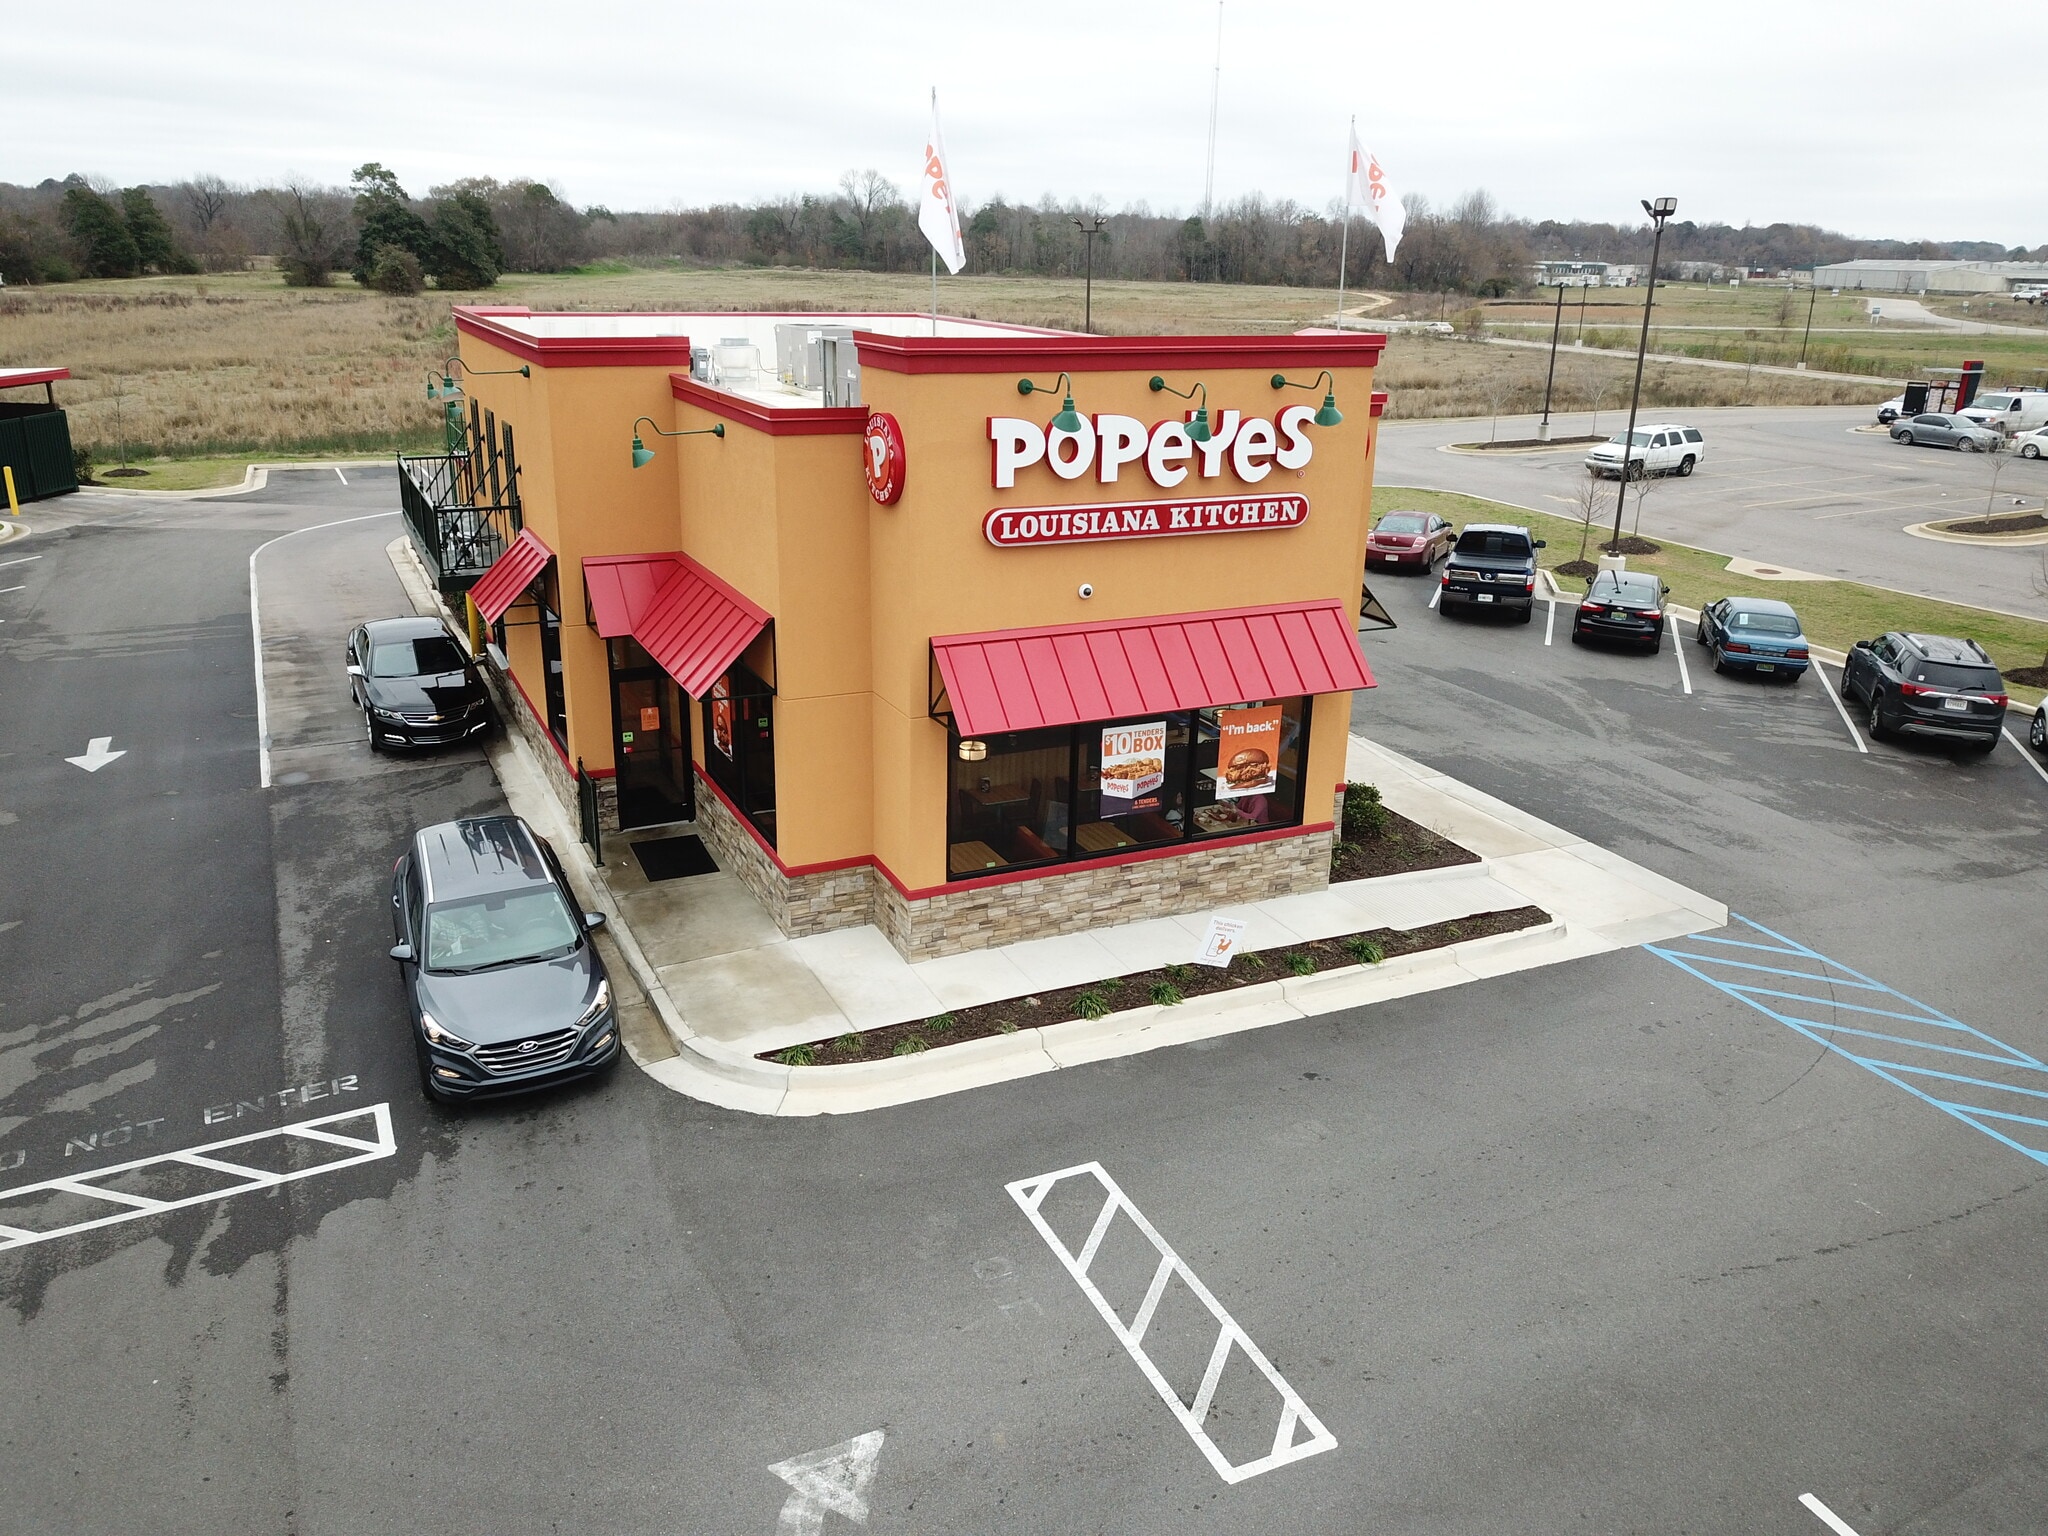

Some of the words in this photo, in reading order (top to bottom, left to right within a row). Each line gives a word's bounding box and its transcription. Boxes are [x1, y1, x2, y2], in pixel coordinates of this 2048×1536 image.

[865, 416, 894, 460] LOUISIANA
[869, 435, 886, 478] P
[865, 467, 893, 501] KITCHEN
[1000, 509, 1160, 539] LOUISIANA
[1169, 500, 1300, 528] KITCHEN
[1105, 732, 1131, 756] $10
[1133, 735, 1163, 753] BOX
[1134, 728, 1164, 737] TENDERS
[65, 1118, 165, 1157] NOT
[203, 1074, 359, 1125] ENTER
